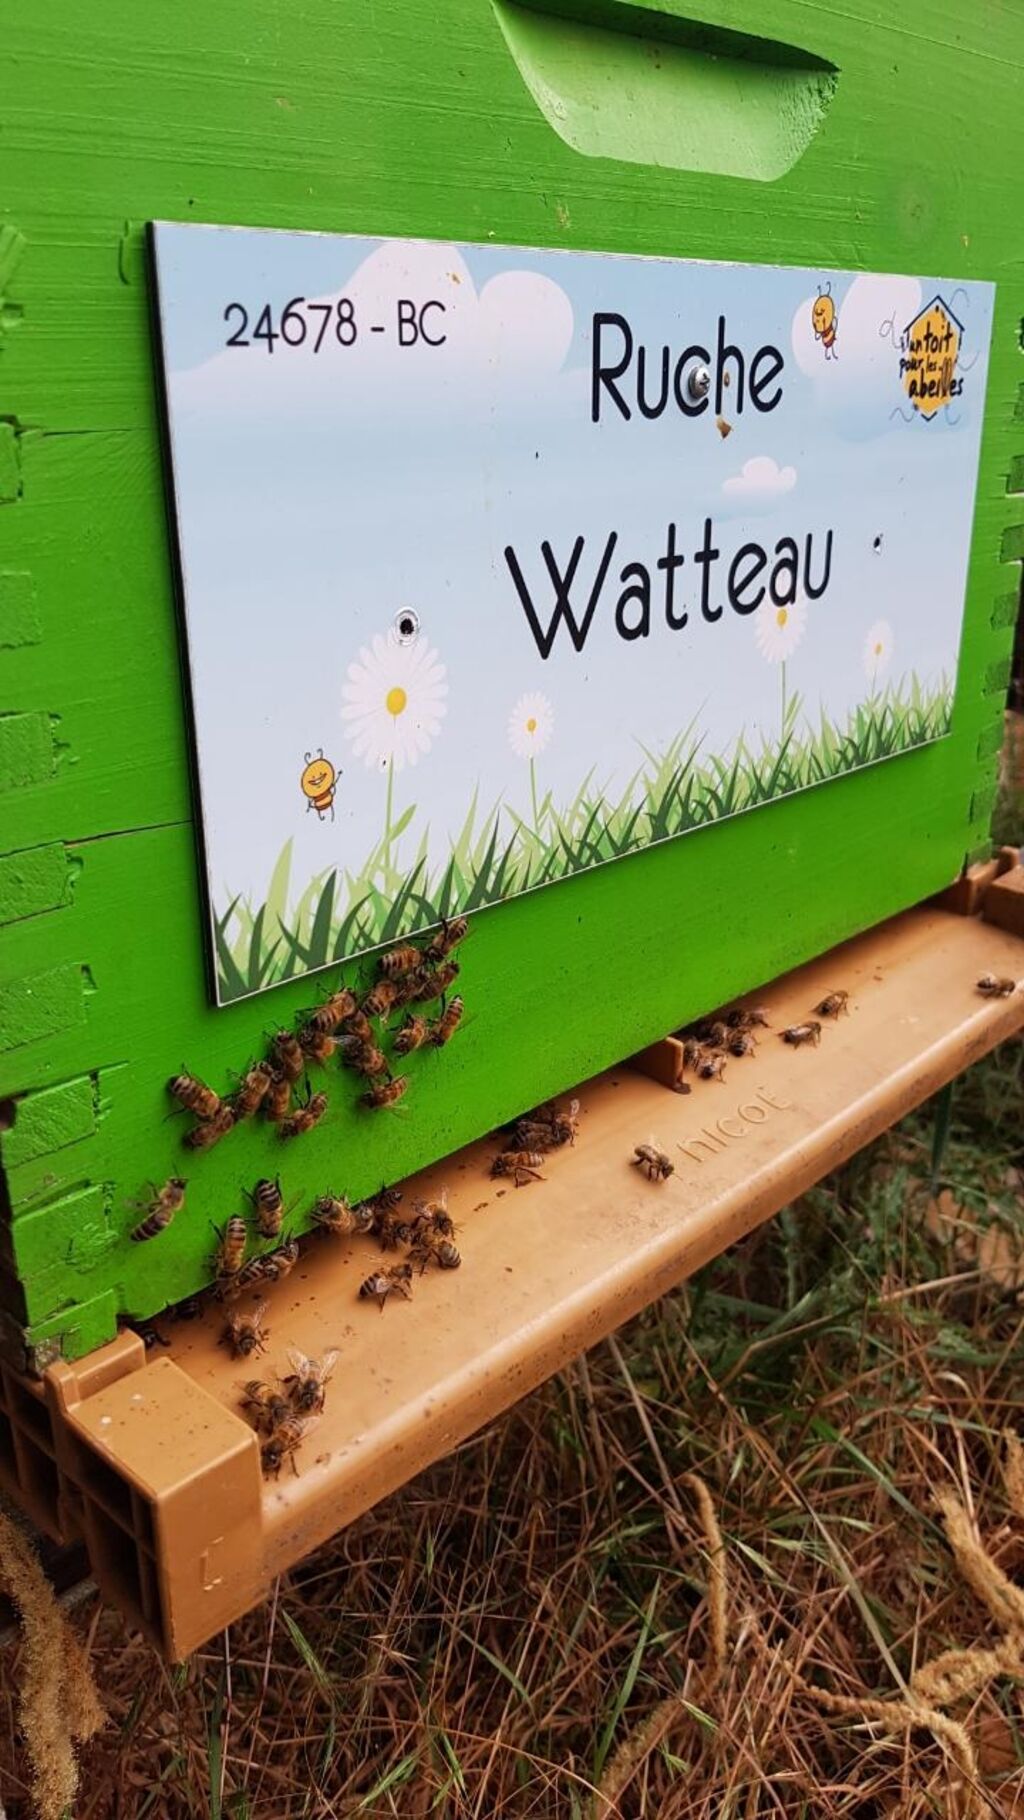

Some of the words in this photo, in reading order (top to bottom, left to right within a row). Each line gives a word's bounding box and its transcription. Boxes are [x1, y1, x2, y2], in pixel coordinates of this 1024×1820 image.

[223, 296, 358, 354] 24678
[397, 299, 447, 347] BC
[923, 320, 954, 354] toit
[590, 312, 785, 423] Ruche
[899, 357, 923, 379] pour
[925, 355, 938, 373] les
[503, 516, 834, 661] Watteau
